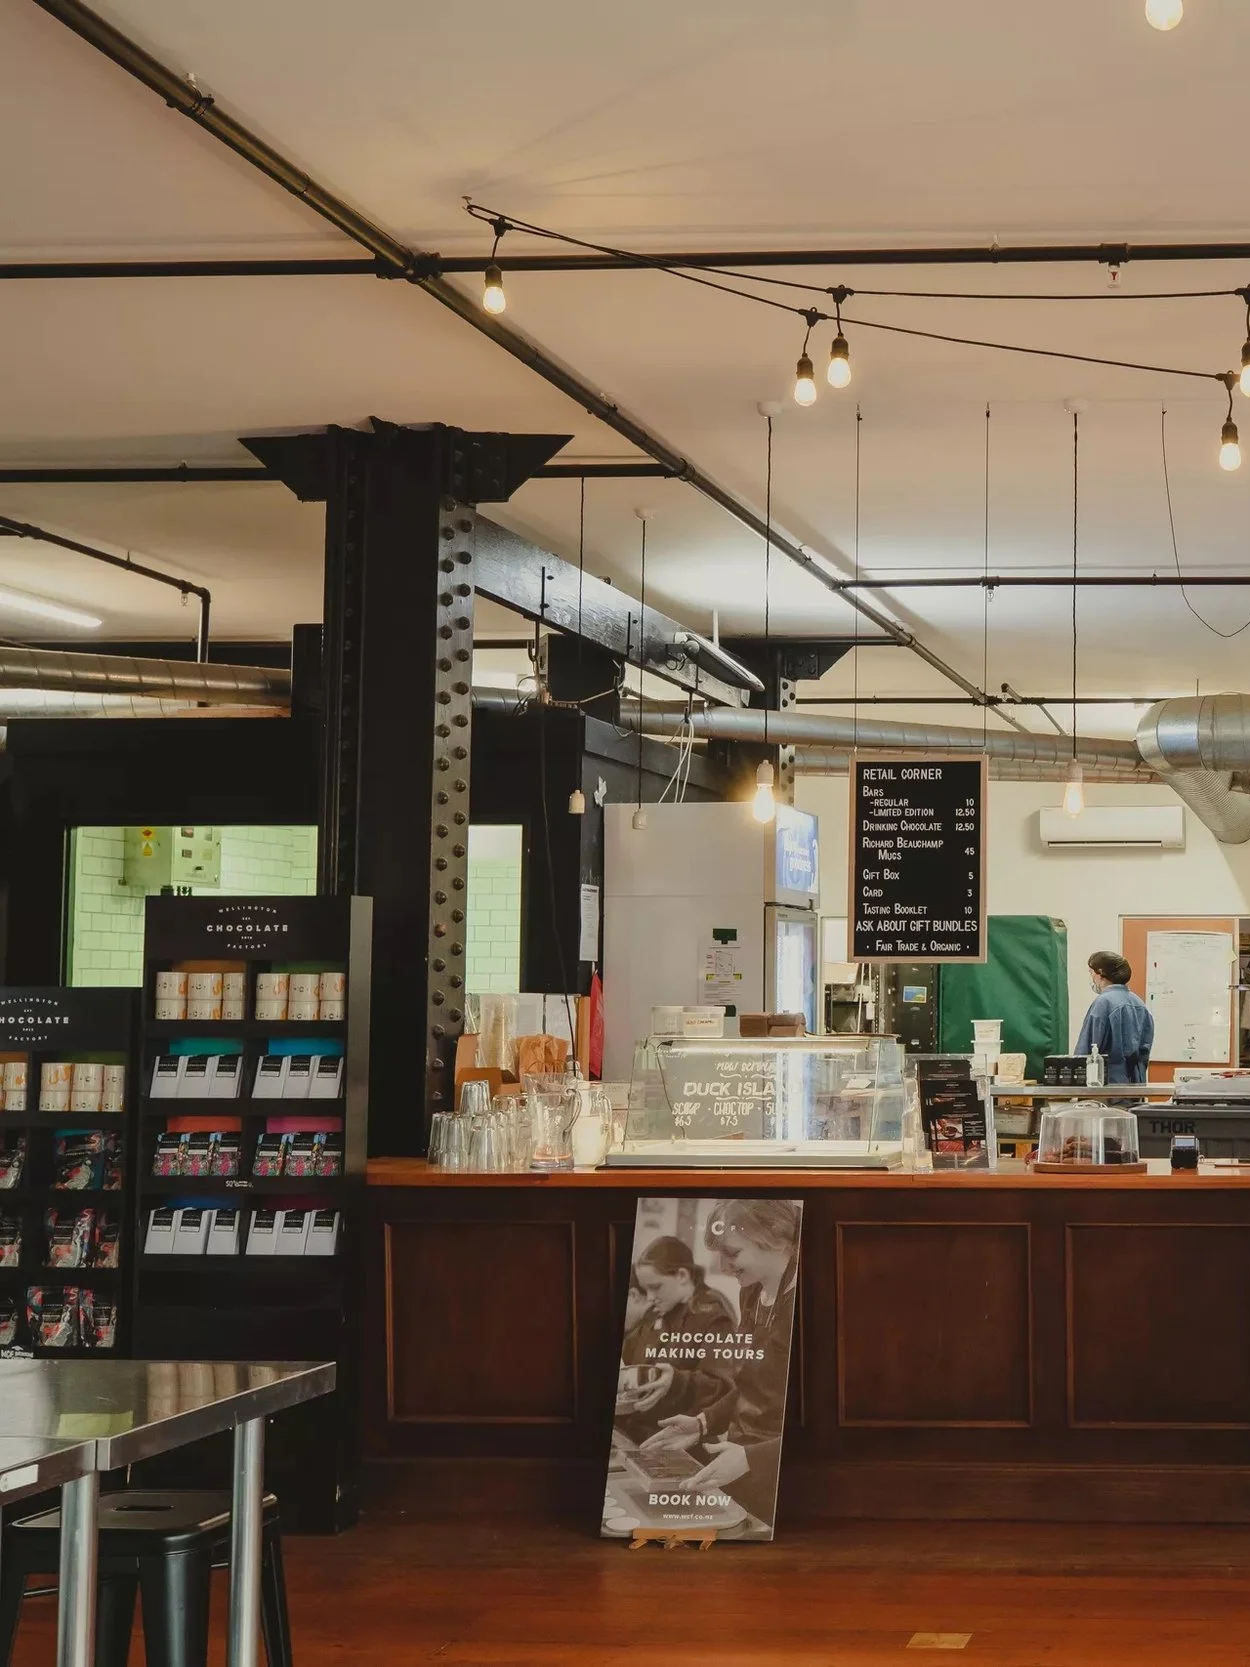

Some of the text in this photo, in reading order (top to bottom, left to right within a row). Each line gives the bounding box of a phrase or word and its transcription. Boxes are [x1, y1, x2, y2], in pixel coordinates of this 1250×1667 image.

[863, 768, 942, 780] RETAIL CORNER
[863, 786, 884, 797] BARS
[955, 809, 975, 817] 12.50
[863, 820, 942, 831] DRINKING CHOCOLATE
[955, 823, 974, 831] 12.50
[863, 837, 894, 848] RICHARD
[878, 849, 902, 860] MUGS
[965, 847, 975, 855] 45
[863, 869, 899, 880] GIFT BOX
[968, 872, 973, 880] 5
[863, 886, 883, 897] CARD
[967, 889, 972, 897] 3
[863, 903, 927, 914] TASTING BOOKLET
[964, 906, 972, 914] 10
[856, 921, 977, 932] ASK ABOUT GIFT BUNDLES
[876, 940, 961, 951] FAIR TRADE & ORGANIC
[683, 1082, 731, 1096] DUCK
[1150, 1121, 1195, 1133] THOR
[660, 1333, 753, 1344] CHOCOLATE
[645, 1348, 765, 1360] MAKING TOURS
[649, 1494, 731, 1506] BOOK NOW
